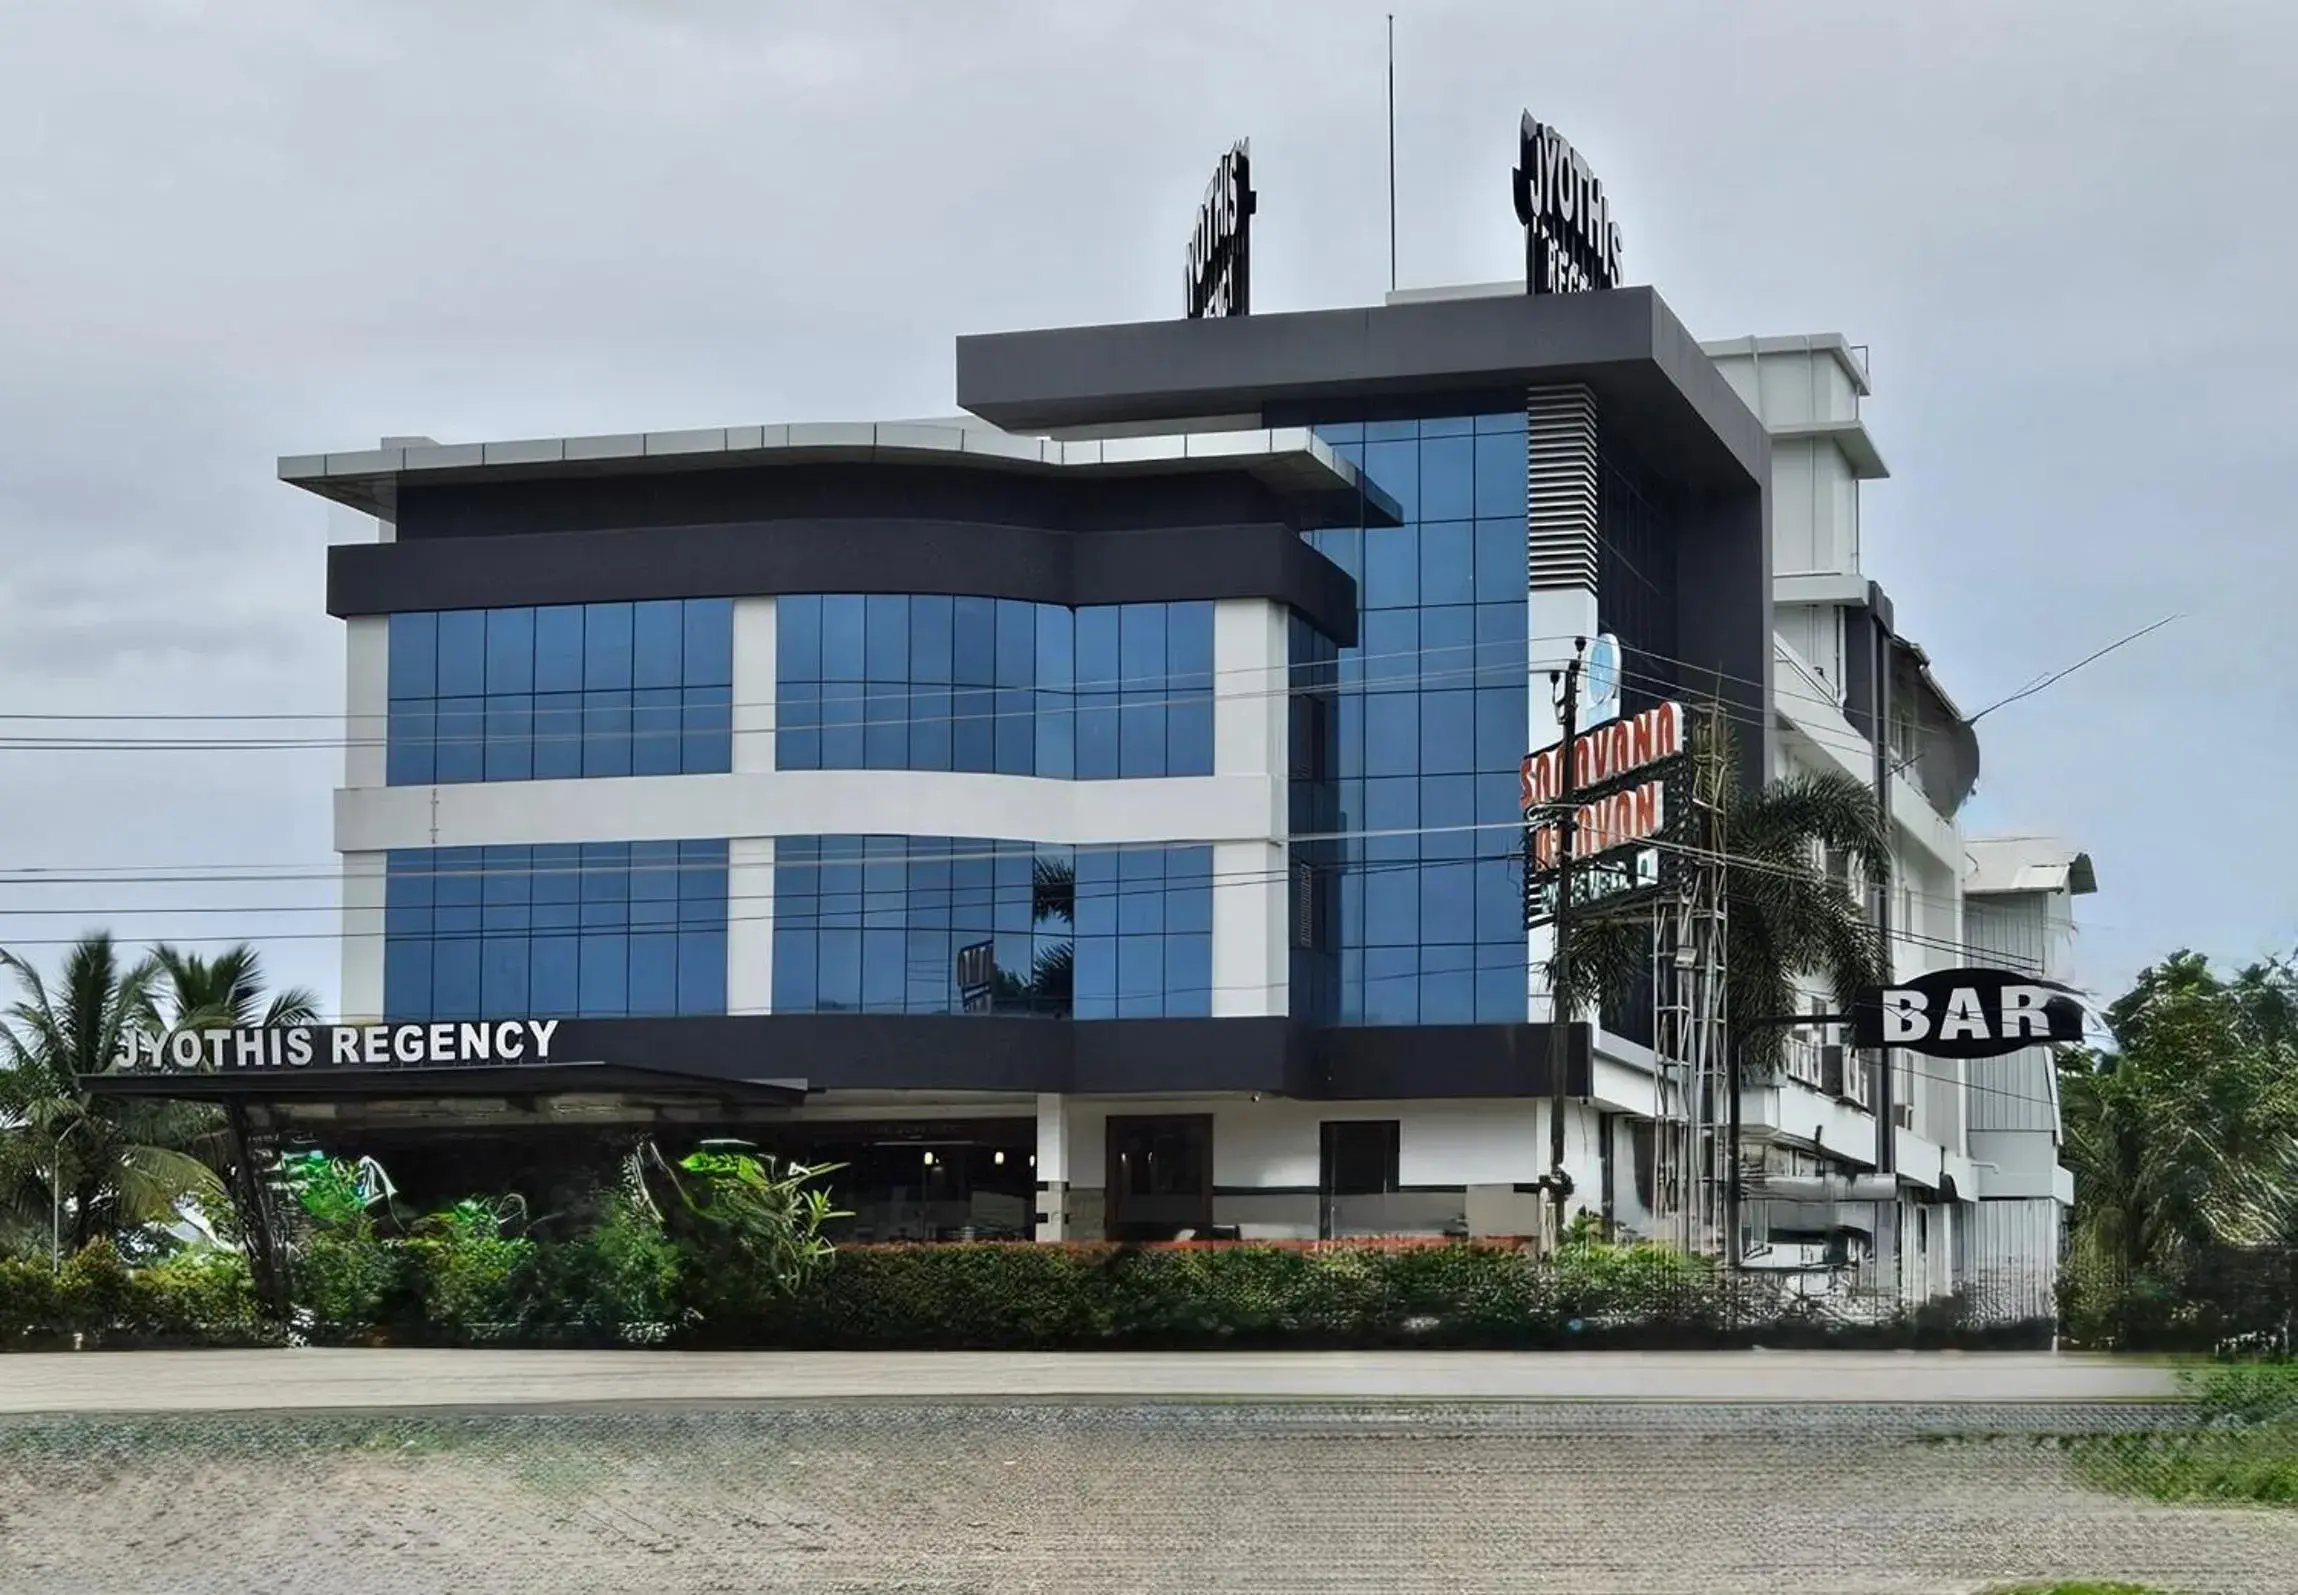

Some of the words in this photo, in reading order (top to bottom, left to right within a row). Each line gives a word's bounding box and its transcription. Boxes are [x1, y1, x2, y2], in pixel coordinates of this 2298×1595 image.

[1530, 124, 1624, 289] JYOTHIS
[1881, 984, 2052, 1043] BAR
[116, 1025, 313, 1069] JYOTHIS
[331, 1019, 559, 1065] REGENCY
